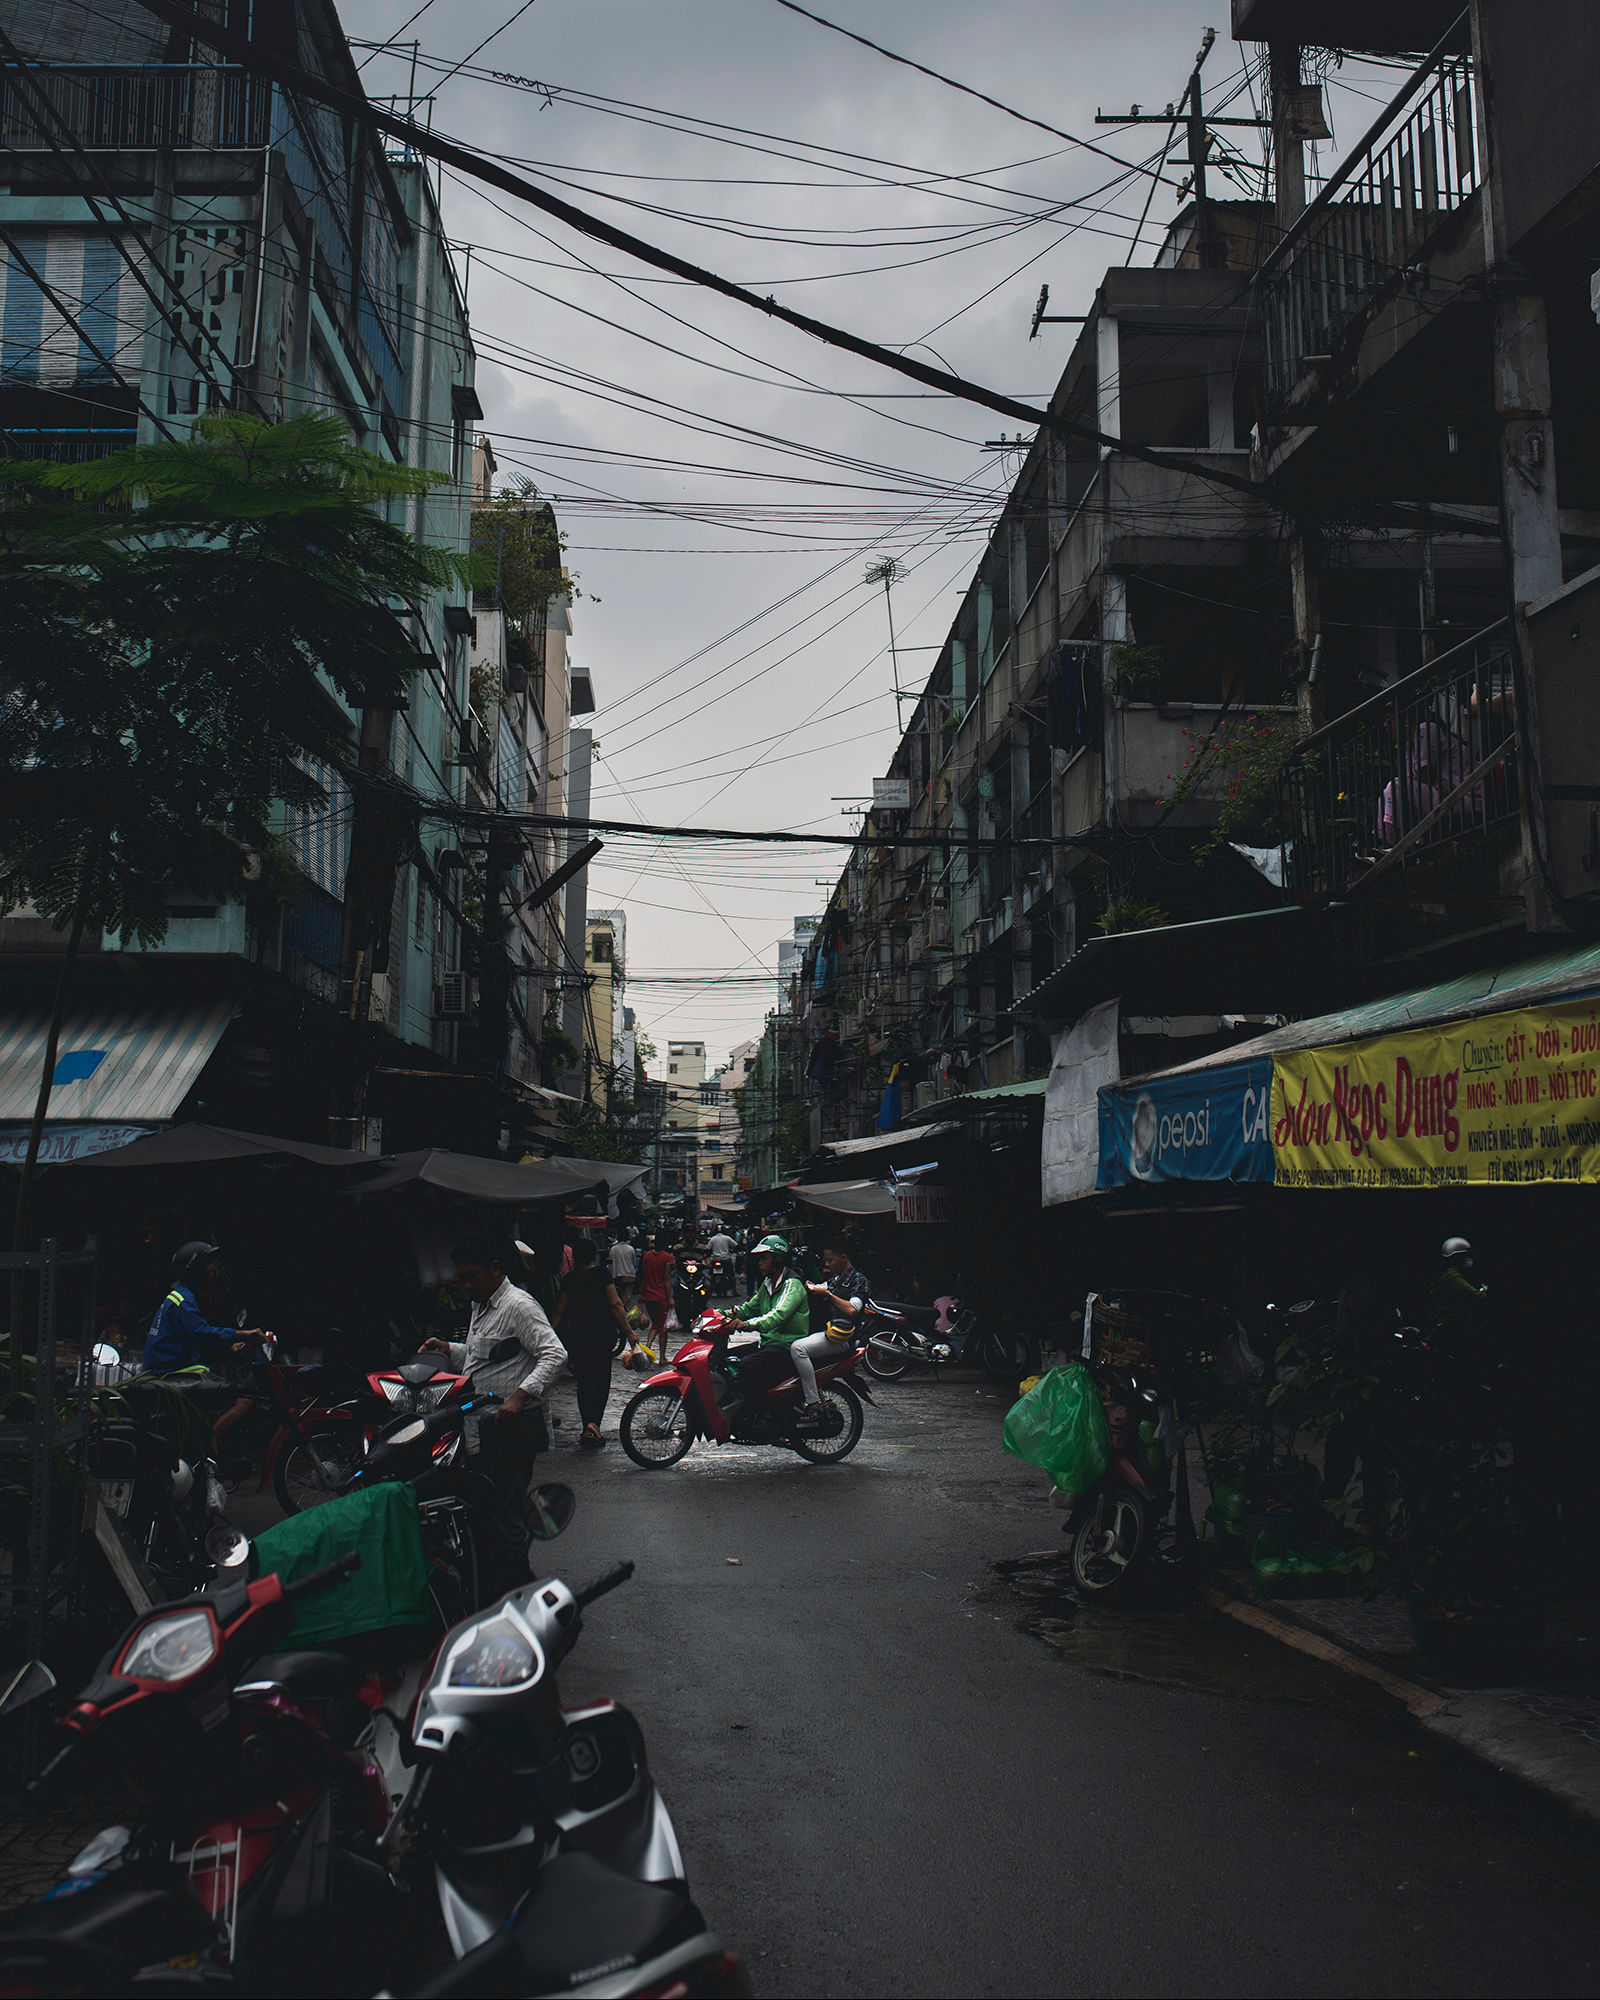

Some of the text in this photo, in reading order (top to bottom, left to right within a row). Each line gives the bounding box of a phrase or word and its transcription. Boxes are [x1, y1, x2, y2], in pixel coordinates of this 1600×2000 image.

[1463, 1039, 1504, 1074] Chuyên:
[1506, 1023, 1526, 1063] CẮT
[1536, 1018, 1560, 1059] UỐN
[1333, 1064, 1387, 1158] Ngọc
[1396, 1056, 1460, 1153] Dung
[1467, 1076, 1497, 1109] MÓNG
[1505, 1067, 1523, 1105] NỐI
[1526, 1076, 1539, 1104] MI
[1571, 1062, 1597, 1099] TÓC
[1158, 1098, 1210, 1161] pepsi
[1242, 1087, 1271, 1144] CA
[1467, 1121, 1498, 1153] KHUYẾN
[1503, 1155, 1522, 1182] NGÀY
[1524, 1159, 1545, 1181] 21/9
[898, 1189, 915, 1221] TÀU
[569, 1953, 637, 1985] HONDA
